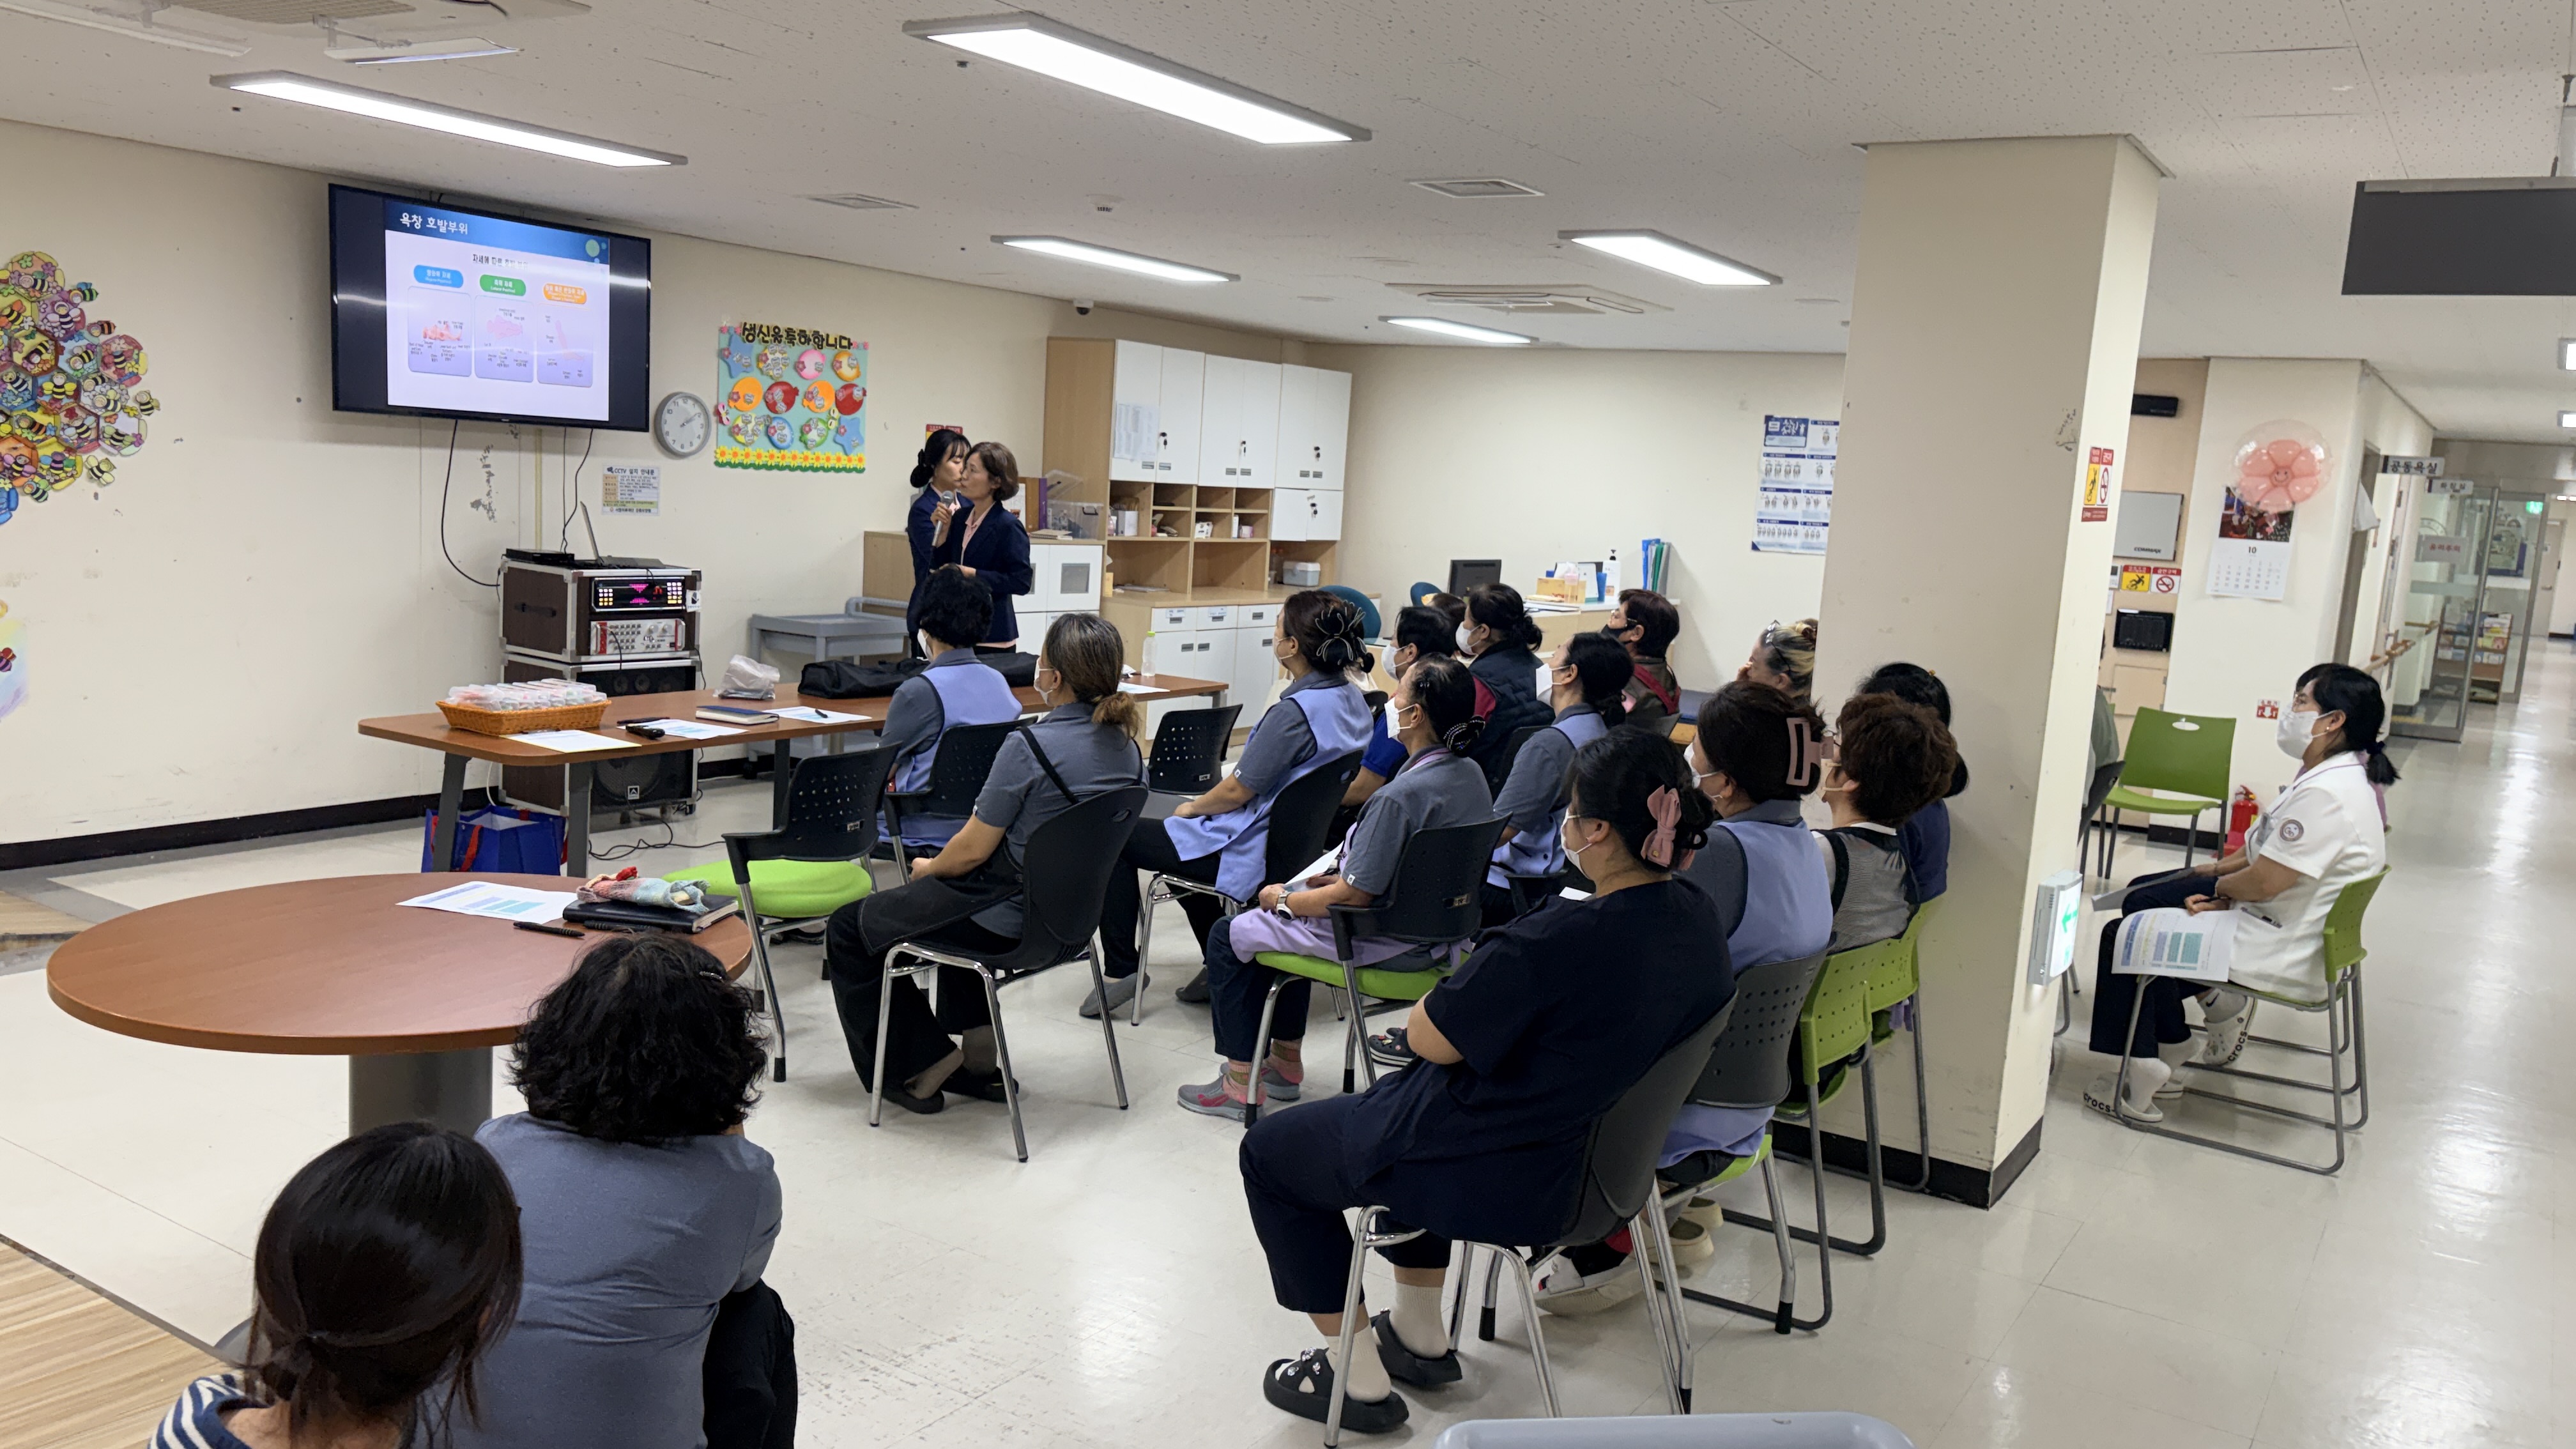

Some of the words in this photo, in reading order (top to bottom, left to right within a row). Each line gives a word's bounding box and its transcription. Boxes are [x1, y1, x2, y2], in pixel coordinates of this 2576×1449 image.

[400, 212, 422, 229] 욕창
[426, 217, 468, 234] 호발부위
[473, 254, 489, 264] 자세에
[491, 257, 502, 266] 따른
[742, 322, 852, 349] 생신을축하합니다
[2390, 461, 2437, 474] 공동욕실
[2228, 1031, 2248, 1061] crocs
[2083, 1093, 2111, 1112] crocs
